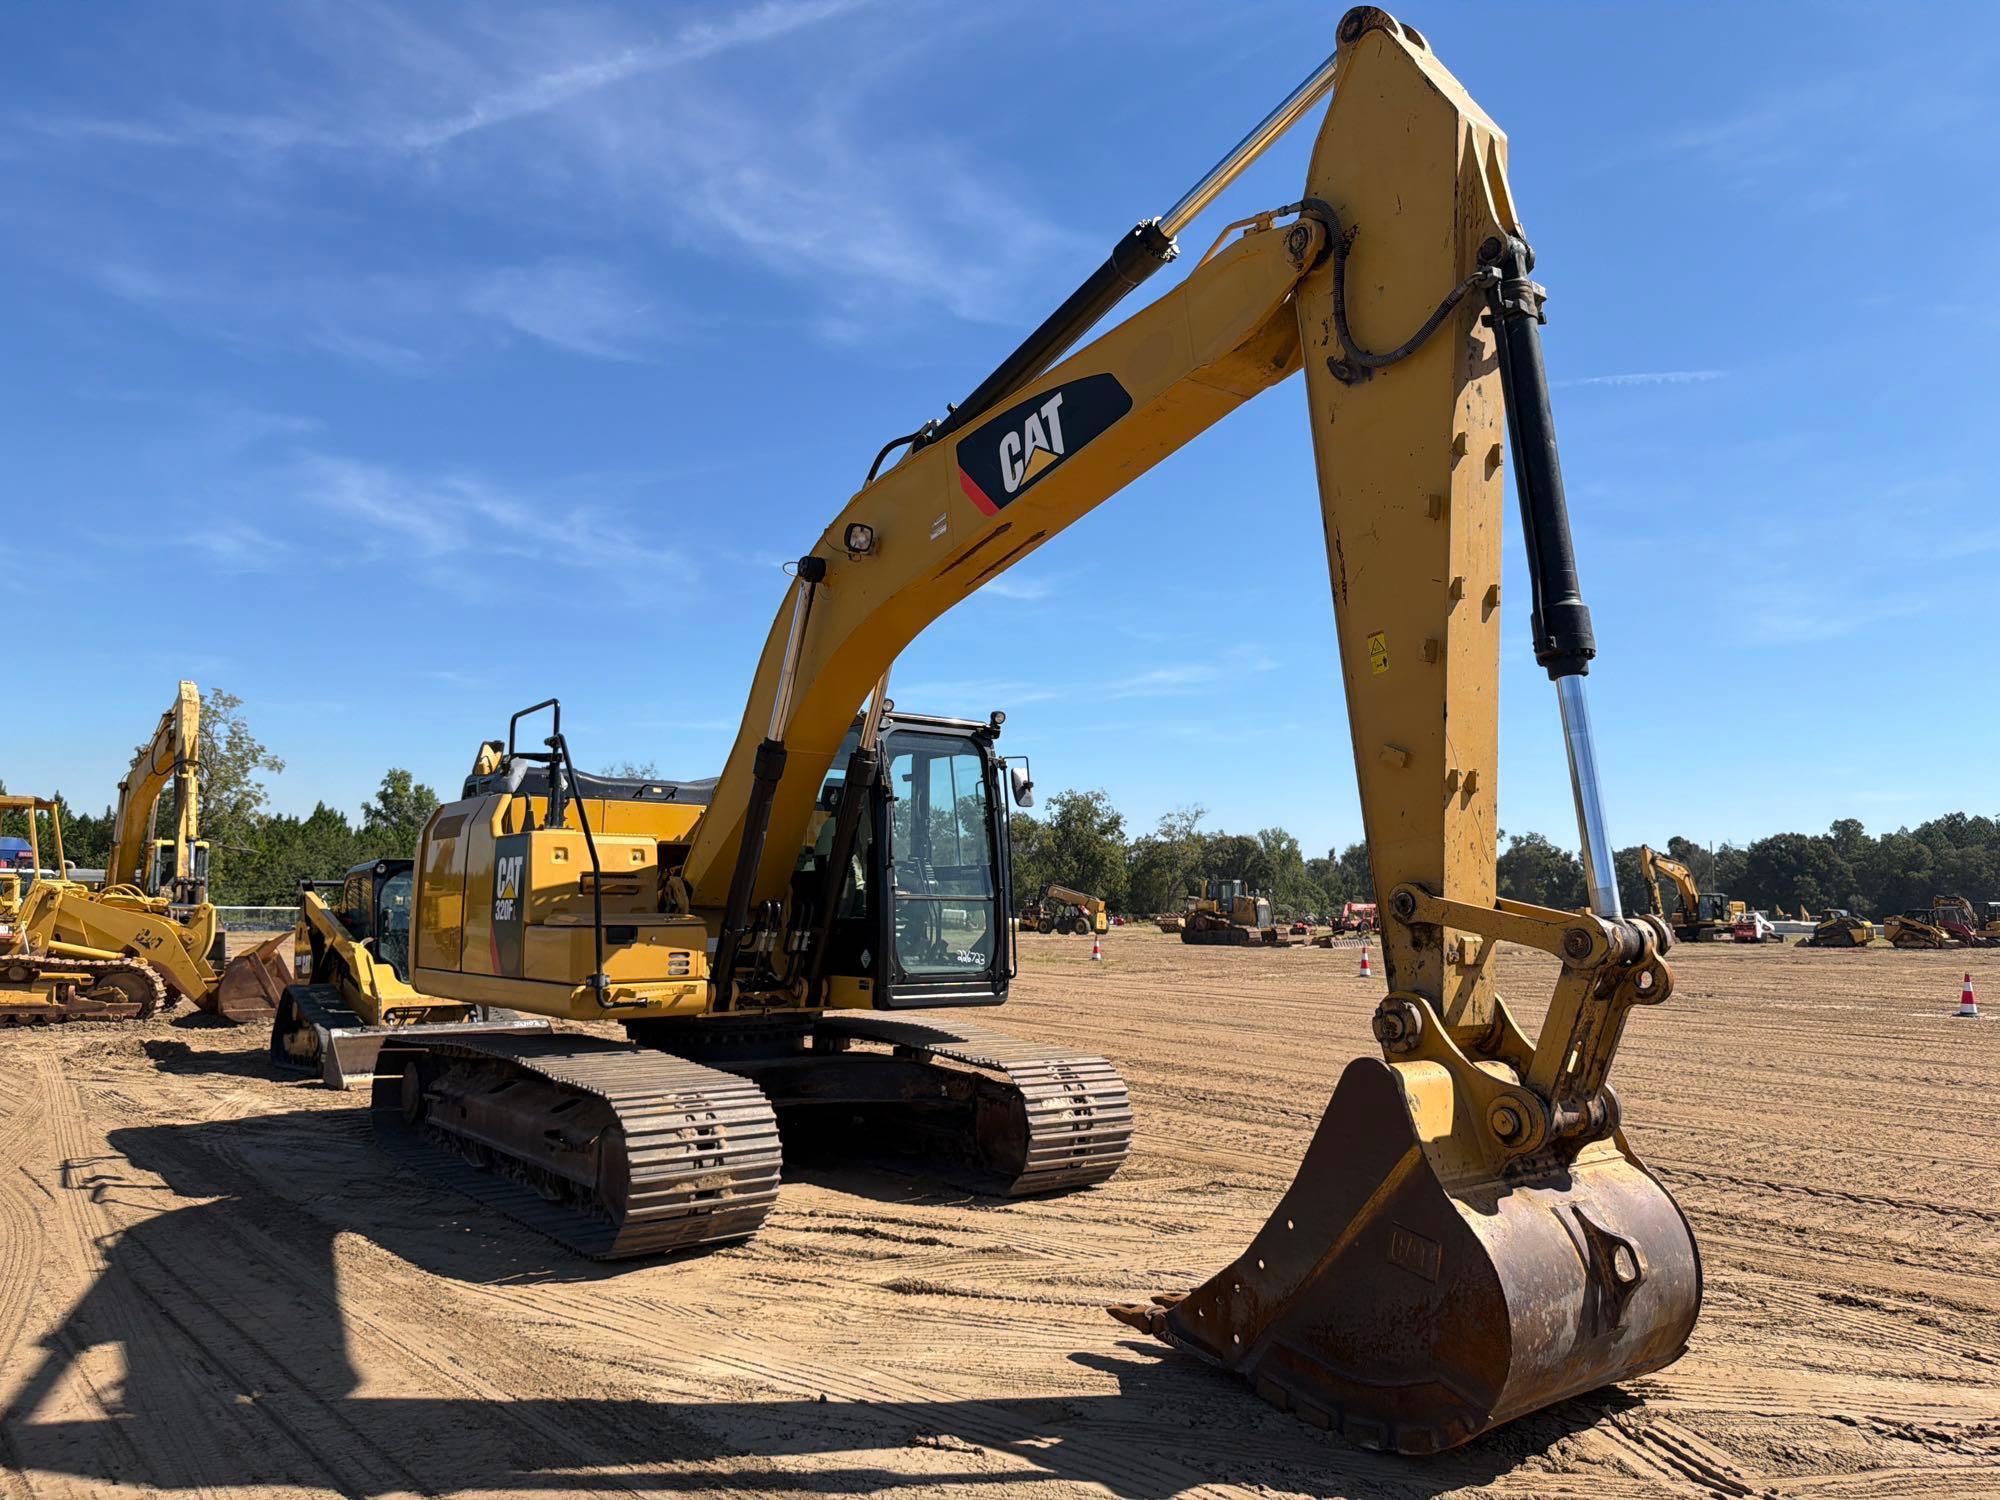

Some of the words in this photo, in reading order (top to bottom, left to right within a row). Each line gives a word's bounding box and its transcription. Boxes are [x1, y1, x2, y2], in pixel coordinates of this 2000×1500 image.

[999, 391, 1065, 494] CAT
[497, 856, 523, 899] CAT
[495, 899, 513, 920] 320F
